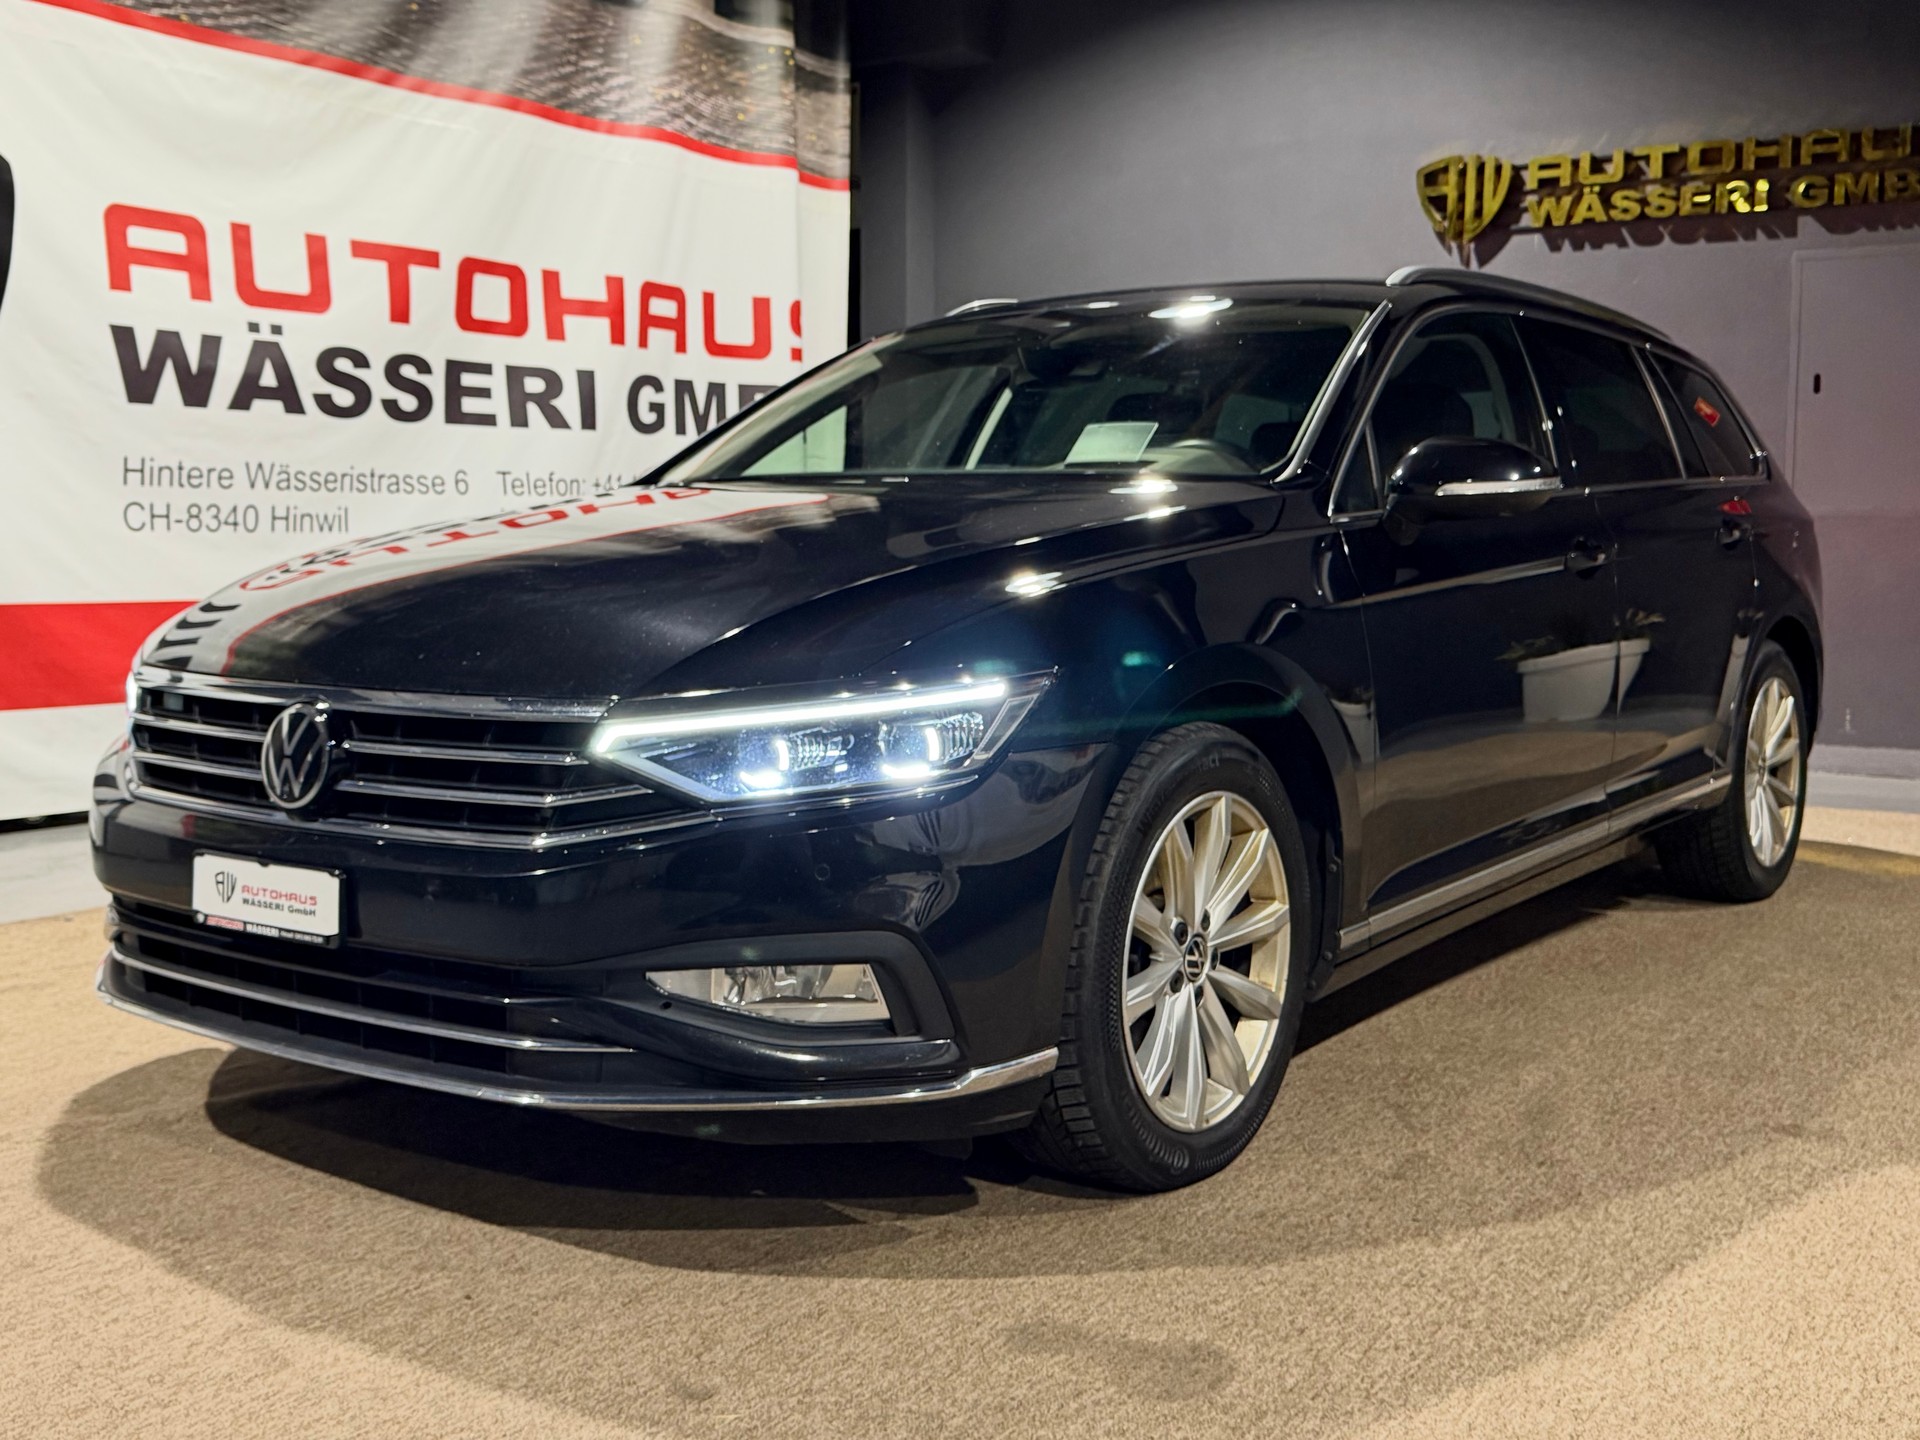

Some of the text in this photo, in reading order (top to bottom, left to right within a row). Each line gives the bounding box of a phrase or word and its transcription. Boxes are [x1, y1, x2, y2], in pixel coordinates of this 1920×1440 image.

[1526, 178, 1770, 228] WÄSSERI
[109, 322, 597, 431] WÄSSERI
[122, 456, 234, 490] Hintere
[245, 461, 446, 496] Wässeristrasse
[454, 469, 470, 496] 6
[497, 471, 584, 497] Telefon:
[123, 501, 349, 534] CH-8340 Hinwil
[241, 884, 317, 906] AUTOHAUS
